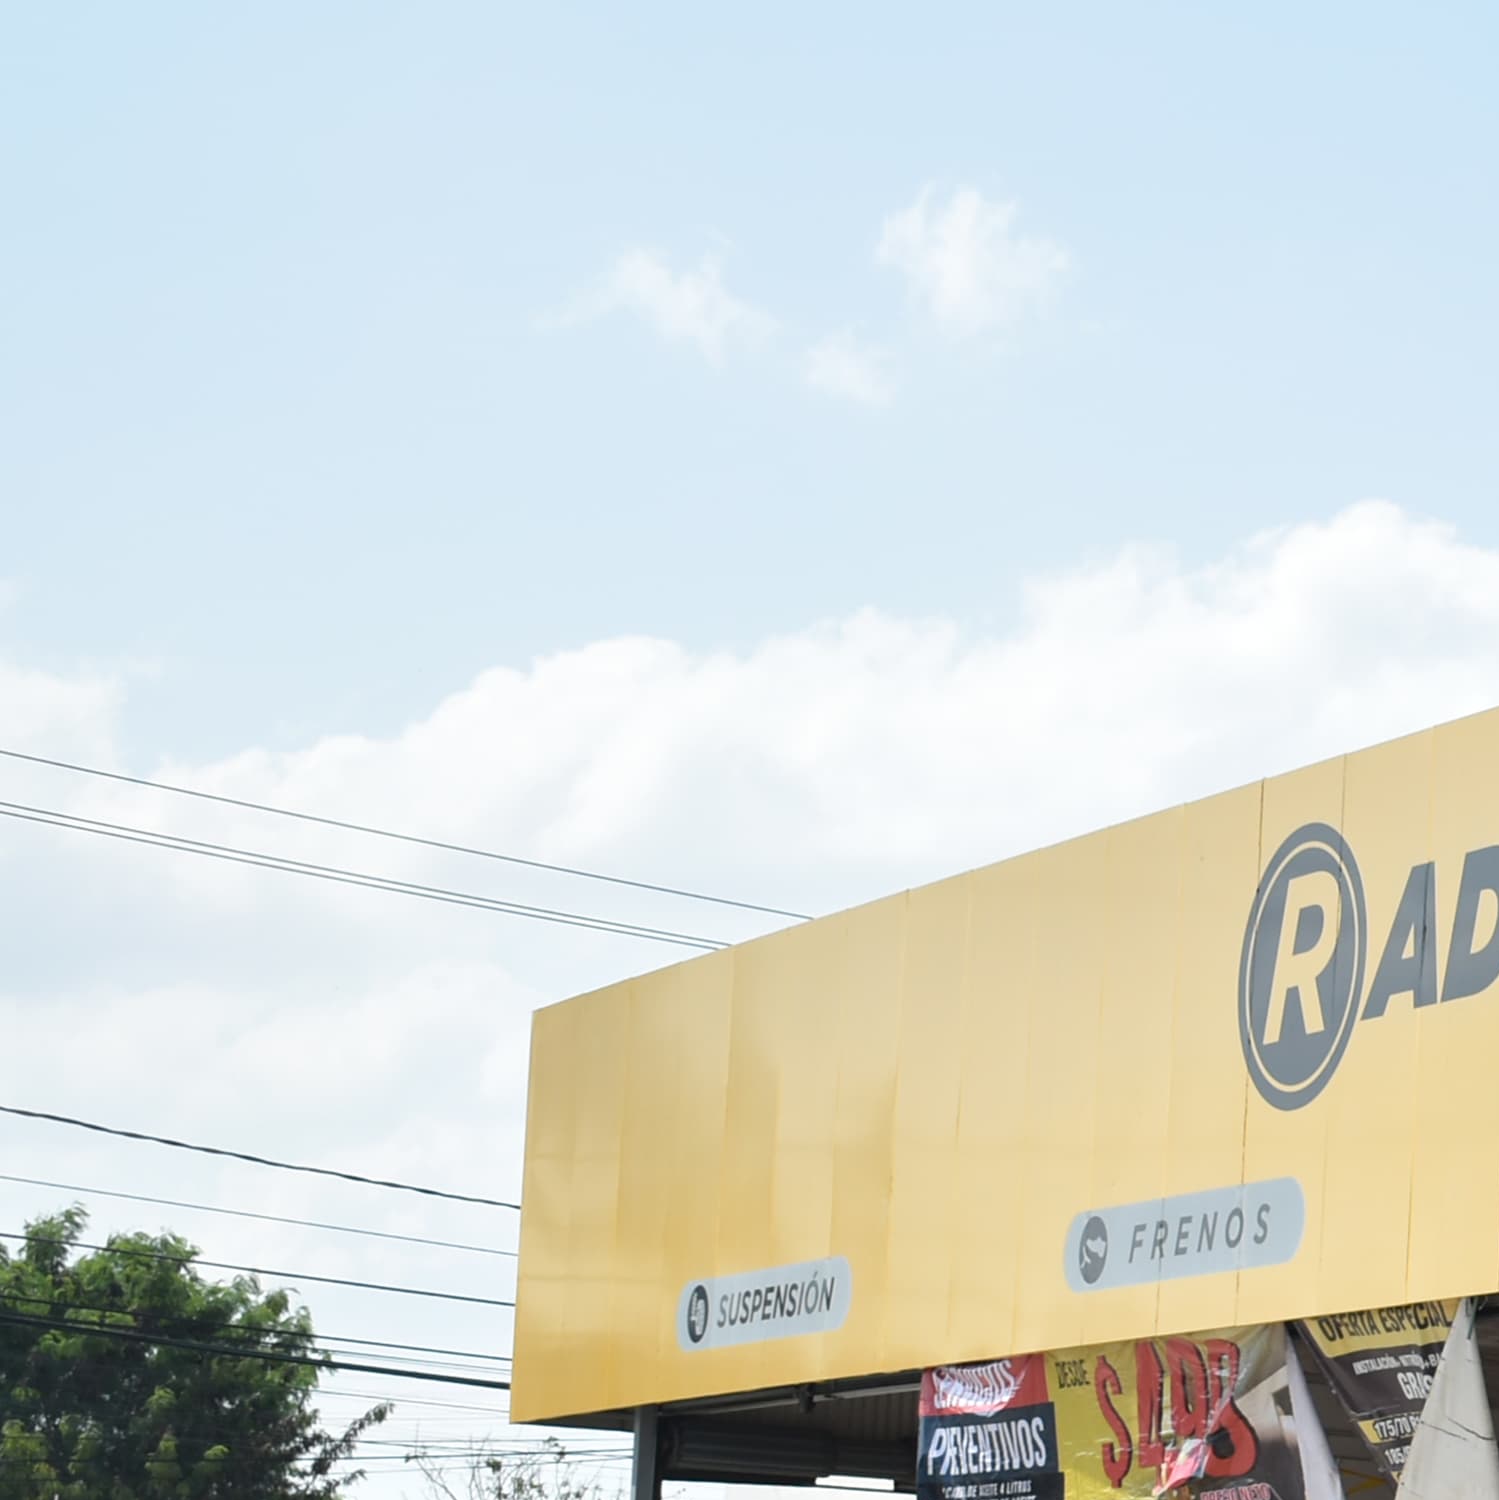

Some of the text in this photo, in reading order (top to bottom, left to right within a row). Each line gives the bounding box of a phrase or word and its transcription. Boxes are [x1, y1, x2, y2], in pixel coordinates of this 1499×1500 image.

[1128, 1203, 1271, 1264] FRENOS
[716, 1270, 835, 1328] SUSPENSIÓN
[1318, 1300, 1453, 1342] OFERTA ESPECIAL
[1055, 1358, 1091, 1389] DESDE
